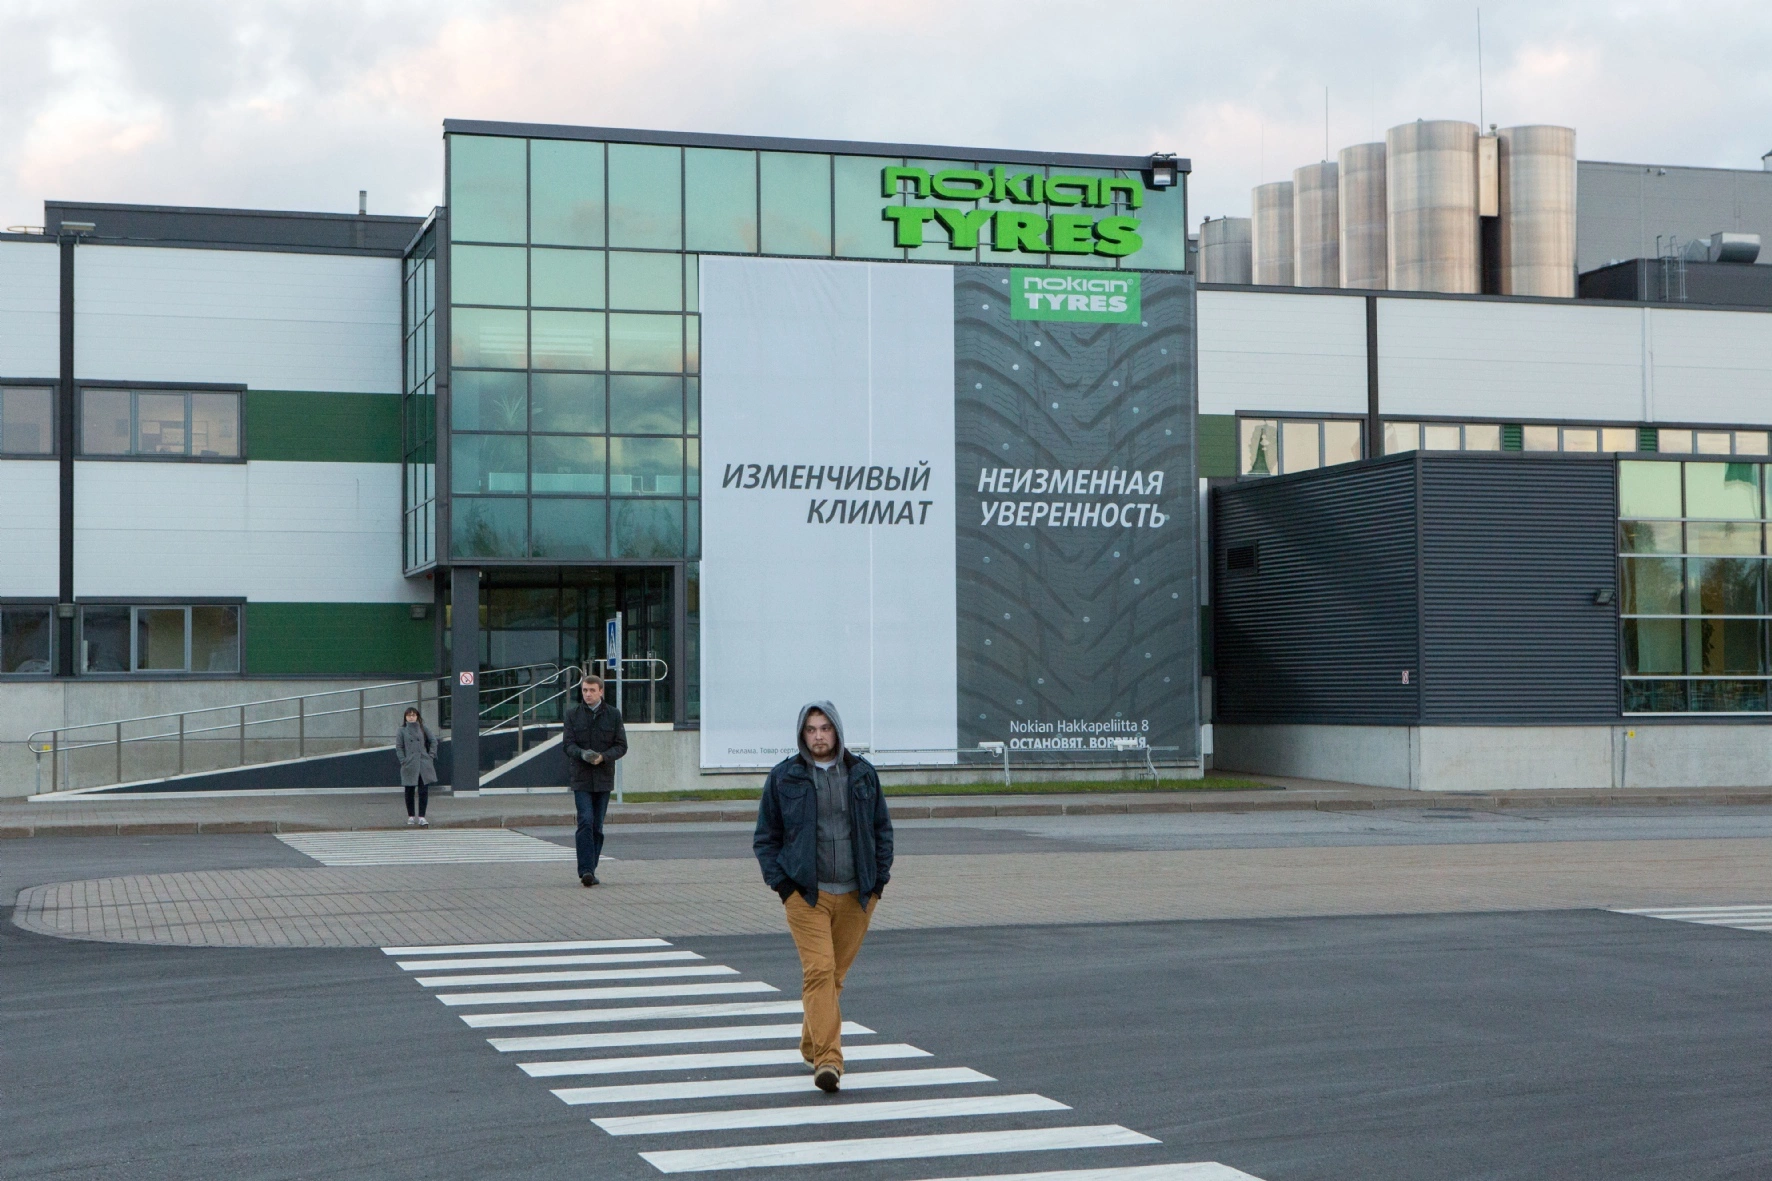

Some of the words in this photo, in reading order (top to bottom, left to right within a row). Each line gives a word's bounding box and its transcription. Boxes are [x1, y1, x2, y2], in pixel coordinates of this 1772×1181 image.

[884, 206, 1143, 257] TYRES
[1024, 293, 1128, 312] TYRES
[721, 460, 931, 491] ИЗМЕНЧИВЫЙ
[977, 468, 1165, 495] НЕИЗМЕННАЯ
[806, 499, 933, 525] КЛИМАТ
[980, 501, 1166, 528] УВЕРЕННОСТЬ
[1010, 719, 1054, 733] Nokian
[1057, 719, 1138, 736] Hakkapeliitta
[1141, 719, 1149, 732] 8
[727, 747, 759, 755] Реклама.
[760, 747, 779, 756] Товар
[1009, 737, 1087, 749] ОСТАНОВЯТ.
